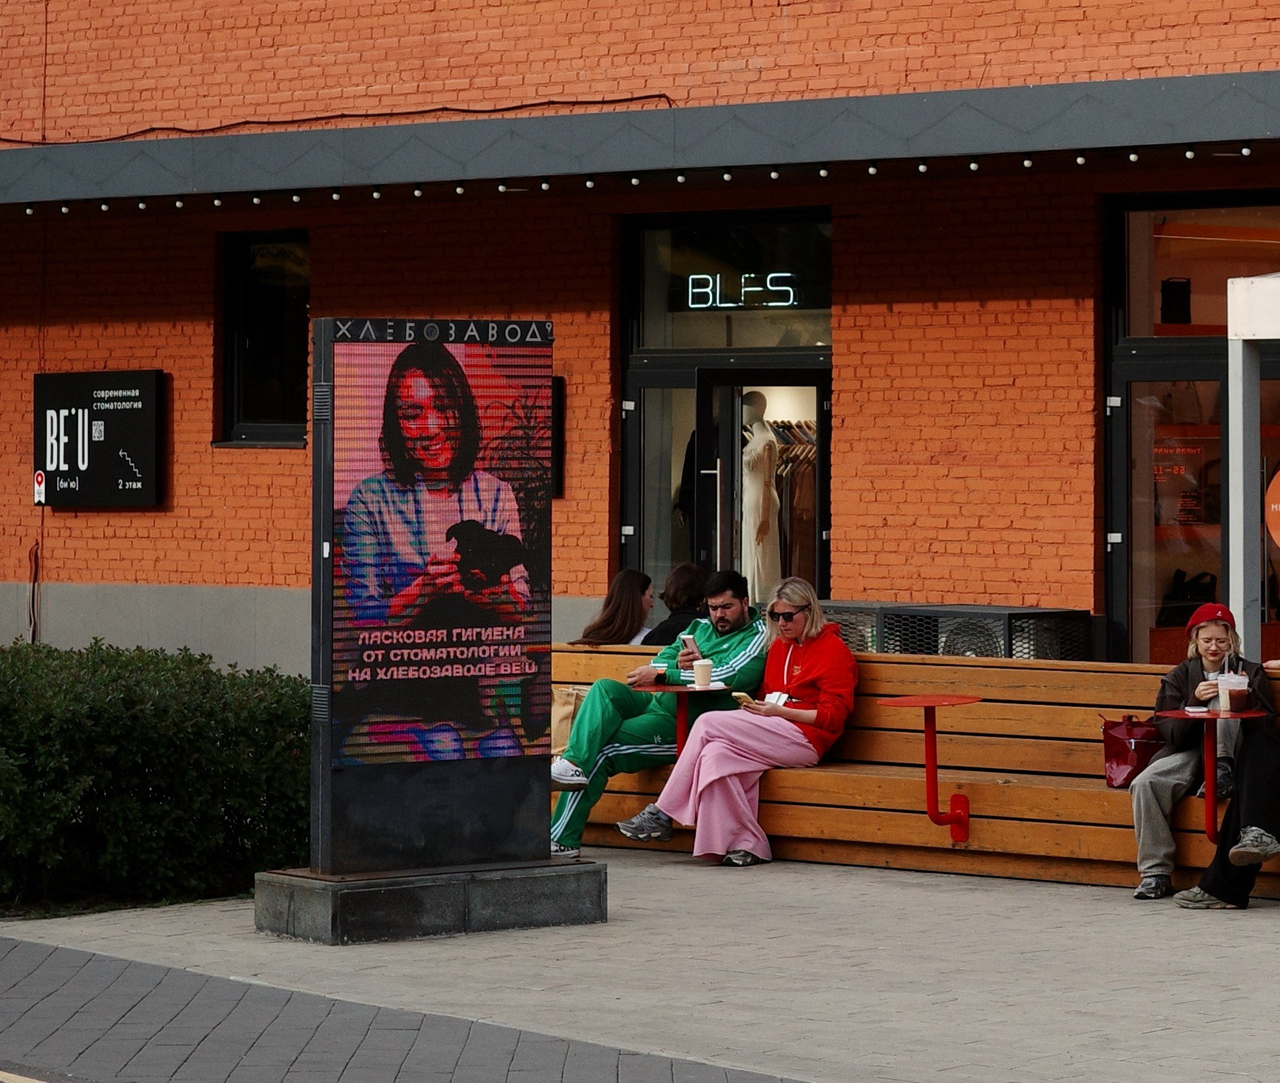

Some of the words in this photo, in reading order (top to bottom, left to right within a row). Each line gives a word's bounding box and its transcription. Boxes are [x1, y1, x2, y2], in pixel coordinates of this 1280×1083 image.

[93, 389, 140, 400] современная
[93, 401, 143, 410] стоматология
[118, 479, 123, 489] 2
[125, 481, 143, 489] этаж
[358, 629, 448, 645] ЛАСКОВАЯ
[452, 625, 526, 642] ГИГИЕНА
[362, 650, 385, 662] ОТ
[389, 644, 522, 662] СТОМАТОЛОГИИ
[348, 668, 371, 681] НА
[376, 663, 496, 681] ХЛЕБОЗАВОДЕ
